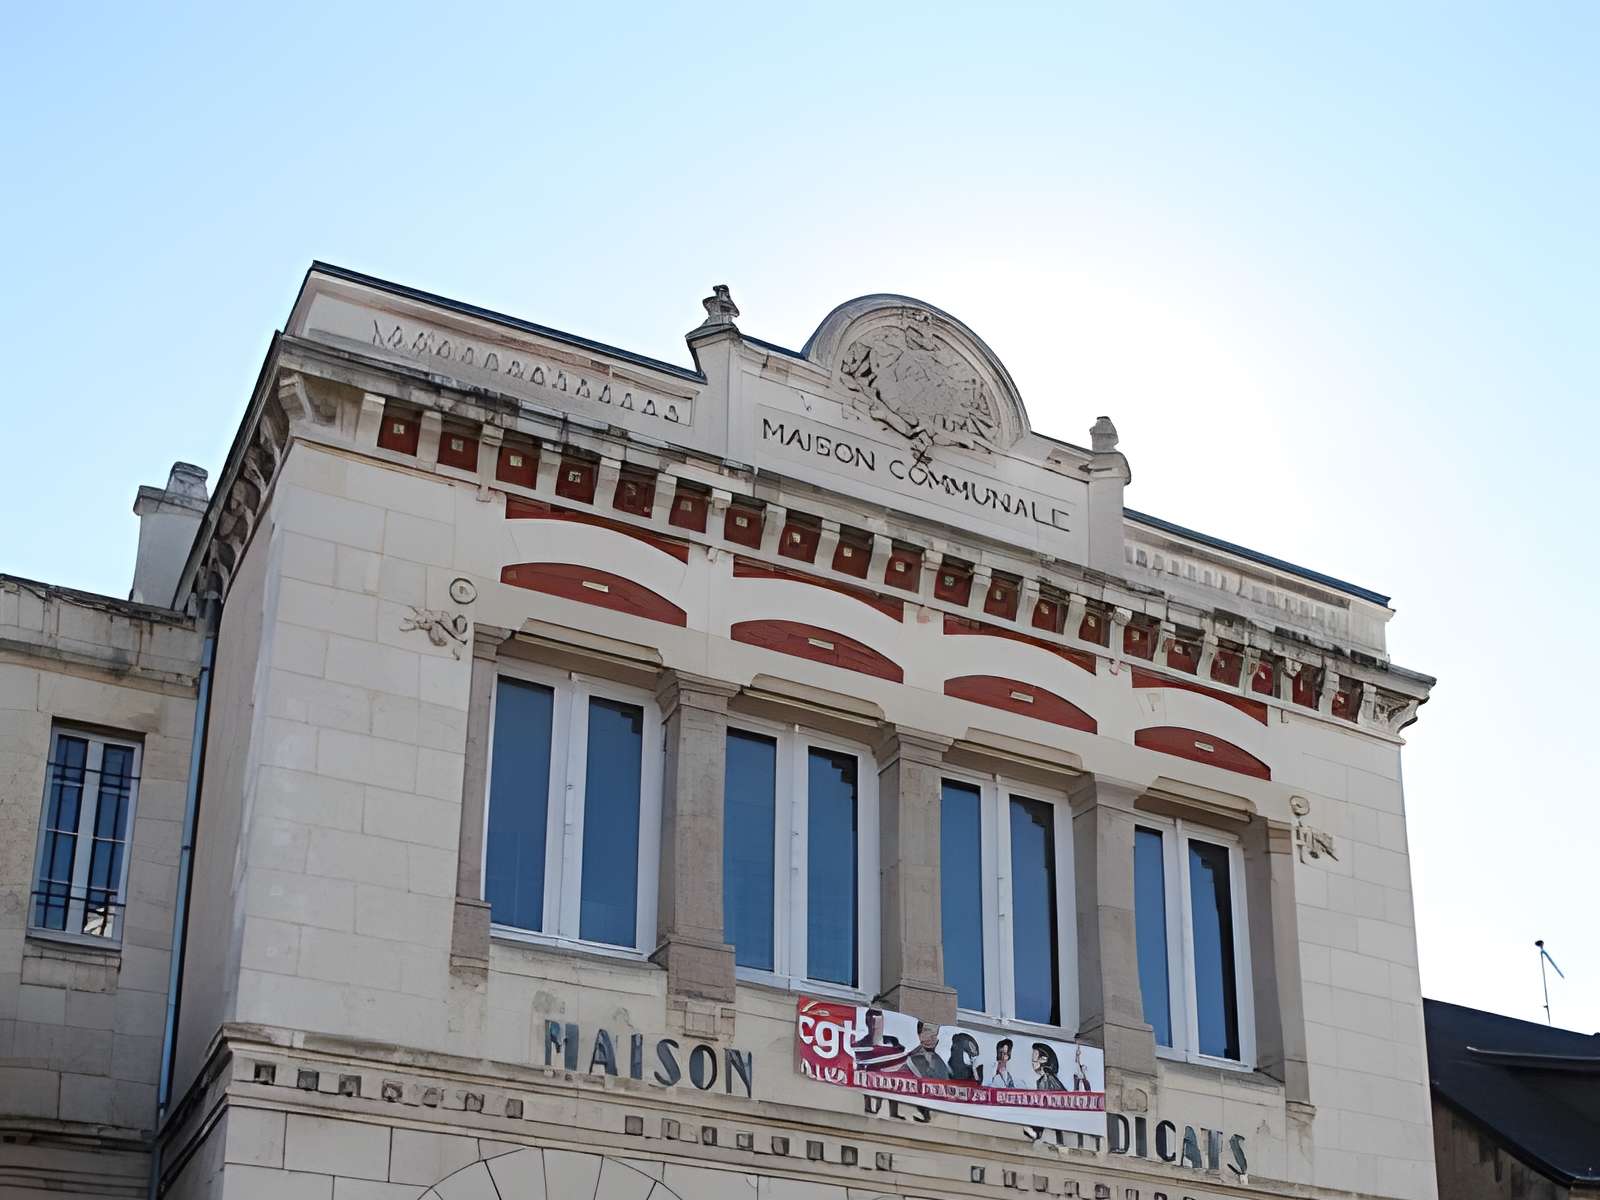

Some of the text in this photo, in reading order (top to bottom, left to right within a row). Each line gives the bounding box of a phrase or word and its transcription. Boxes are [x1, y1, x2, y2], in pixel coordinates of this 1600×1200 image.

[762, 417, 876, 472] MAISON
[544, 1019, 753, 1099] MAISON
[798, 1014, 859, 1059] cgt
